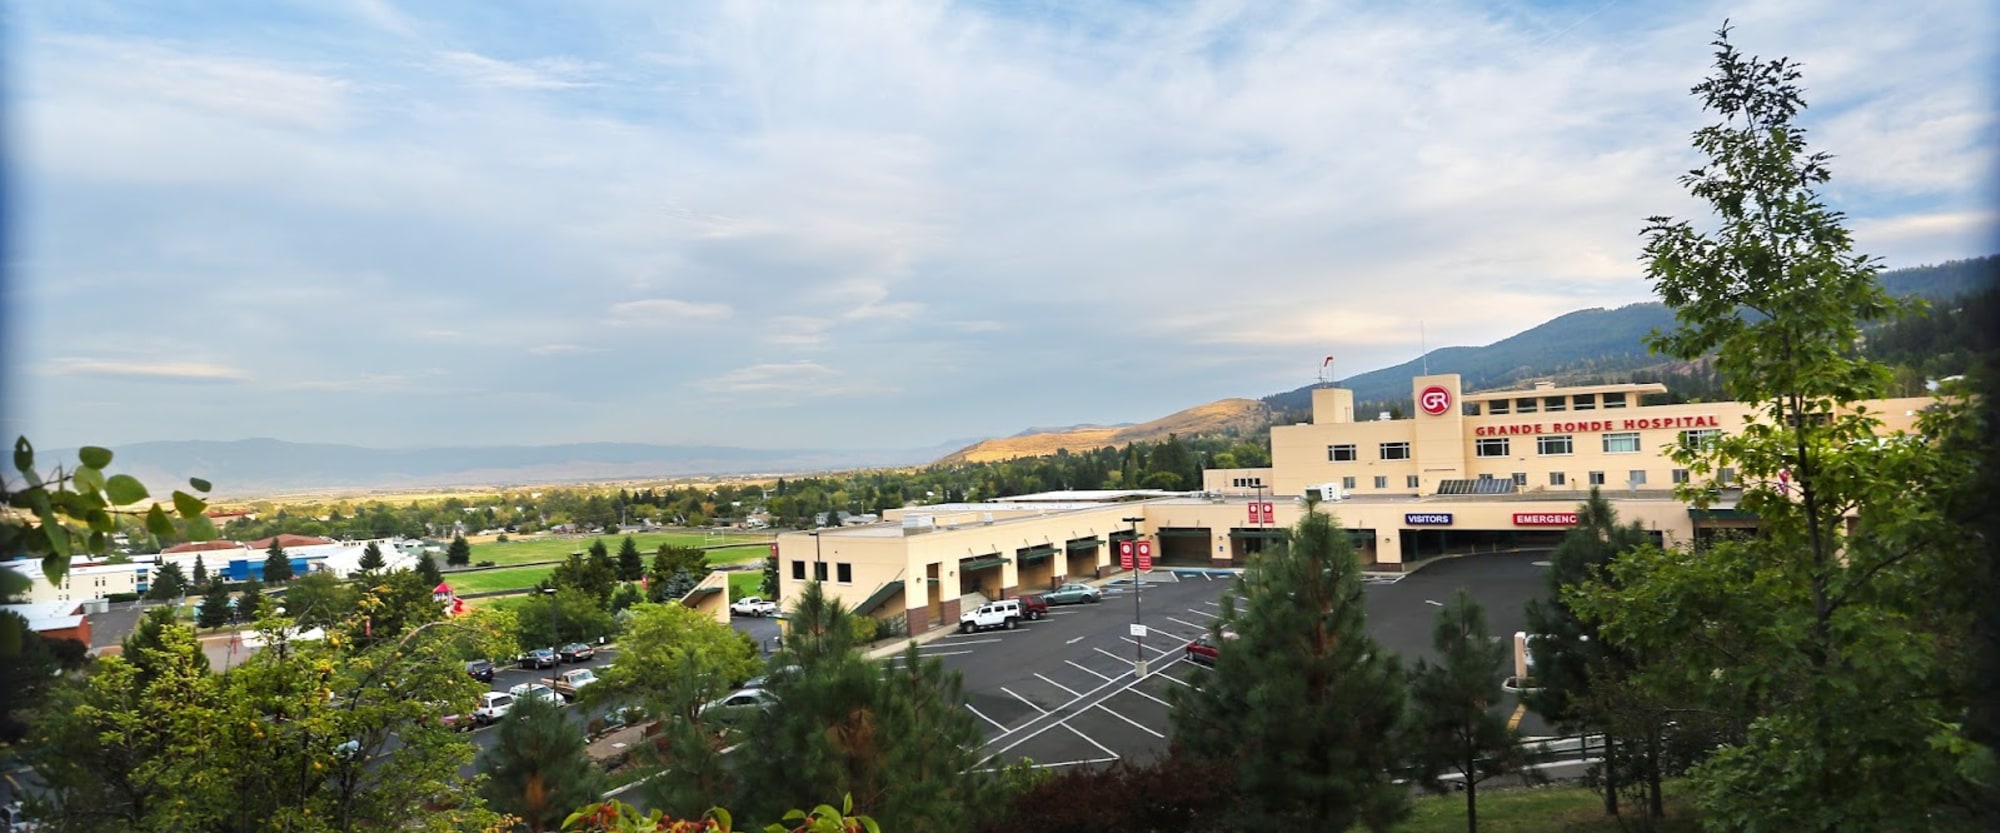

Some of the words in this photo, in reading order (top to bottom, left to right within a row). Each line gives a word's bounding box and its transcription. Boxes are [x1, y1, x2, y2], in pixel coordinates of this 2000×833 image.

[1422, 392, 1448, 409] GR
[1475, 424, 1542, 436] GRANDE
[1553, 421, 1612, 433] RONDE
[1624, 415, 1718, 430] HOSPITAL
[1407, 514, 1449, 524] VISITORS
[1516, 514, 1578, 524] EMERGENC
